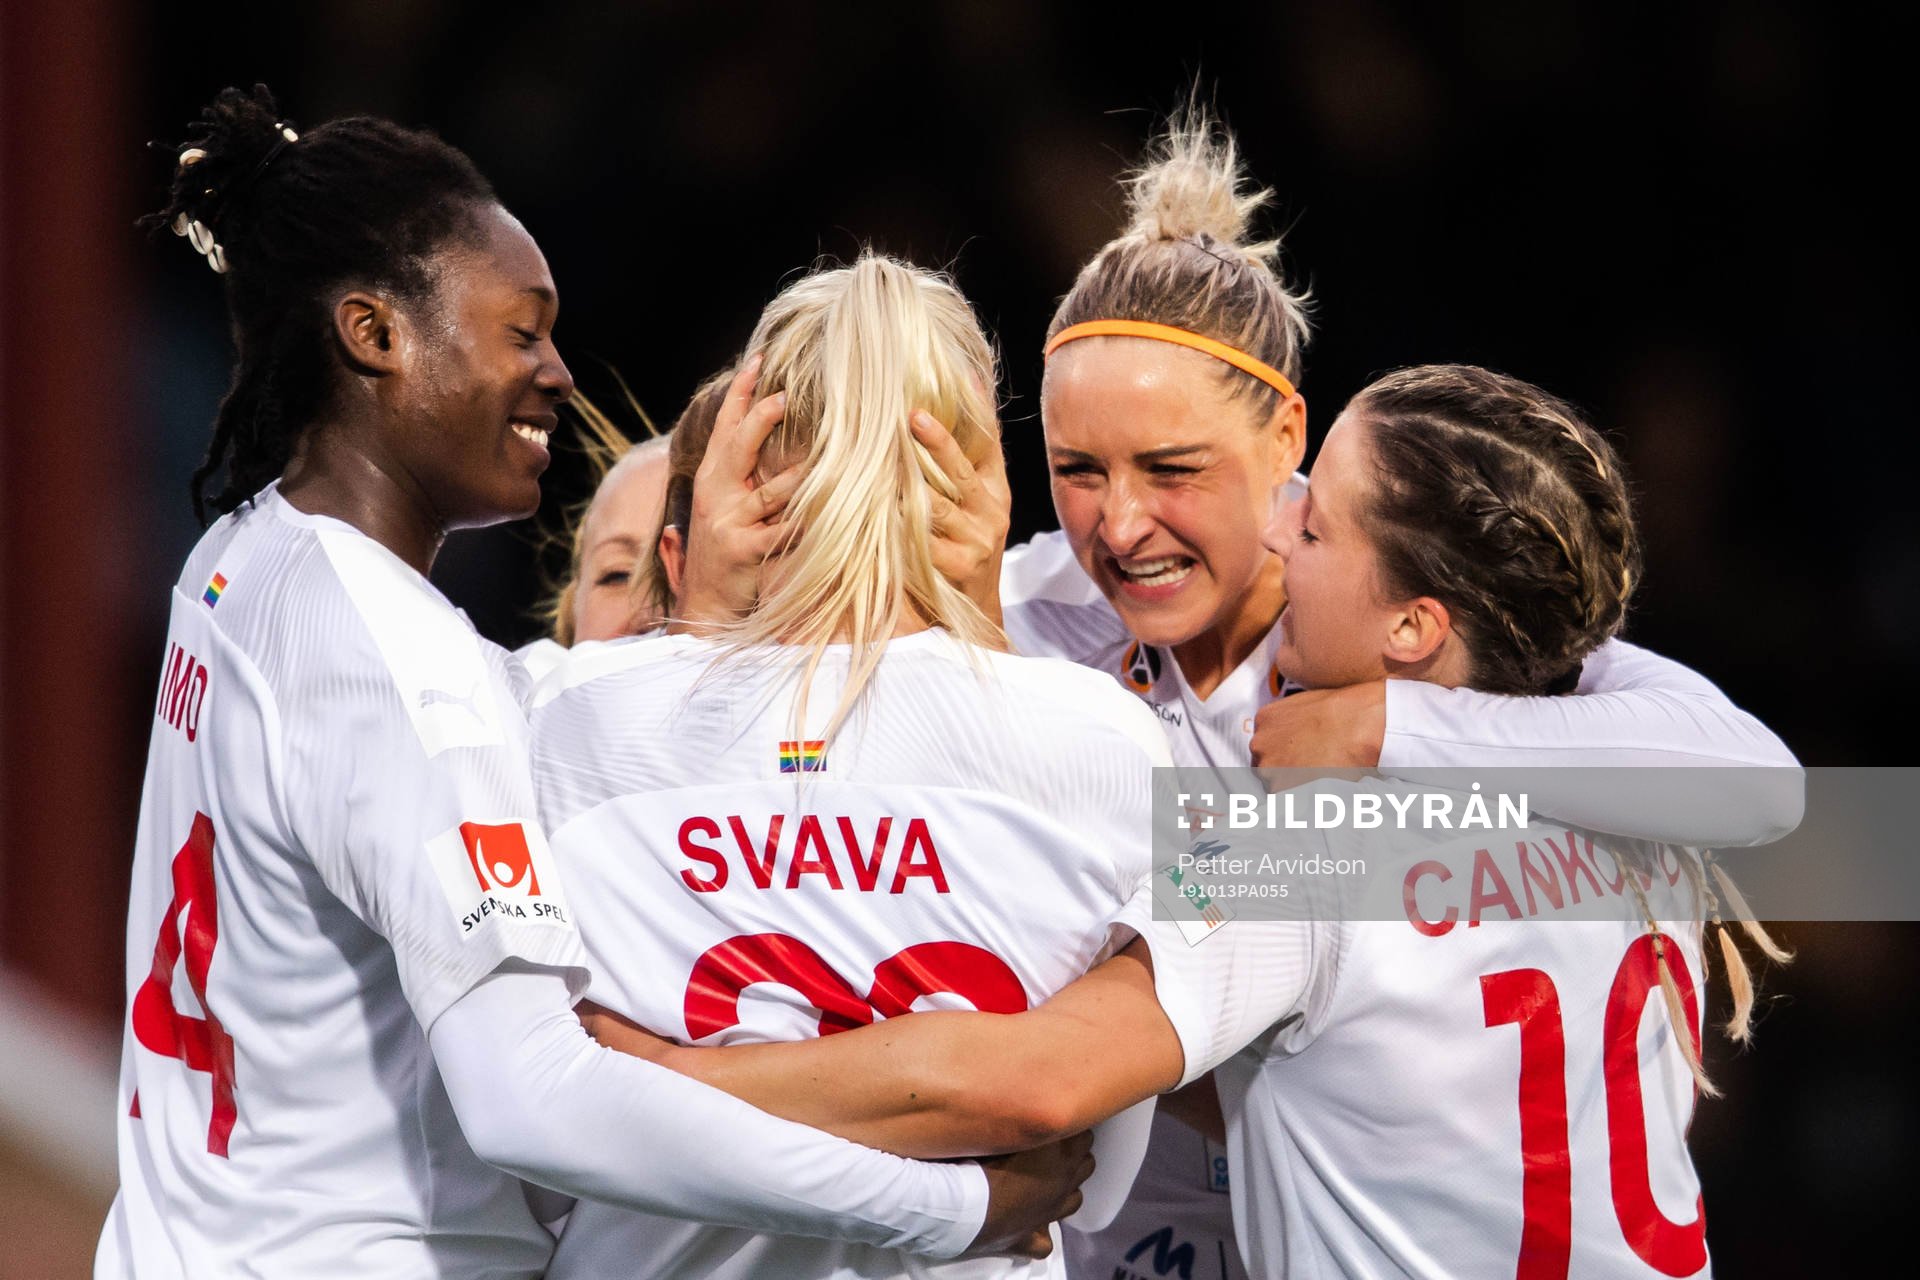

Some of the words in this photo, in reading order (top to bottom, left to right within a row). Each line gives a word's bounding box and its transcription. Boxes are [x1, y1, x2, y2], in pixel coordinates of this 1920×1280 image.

[533, 903, 567, 923] SPEL
[677, 814, 951, 894] SVAVA
[130, 810, 237, 1159] 4
[1479, 932, 1708, 1280] 10
